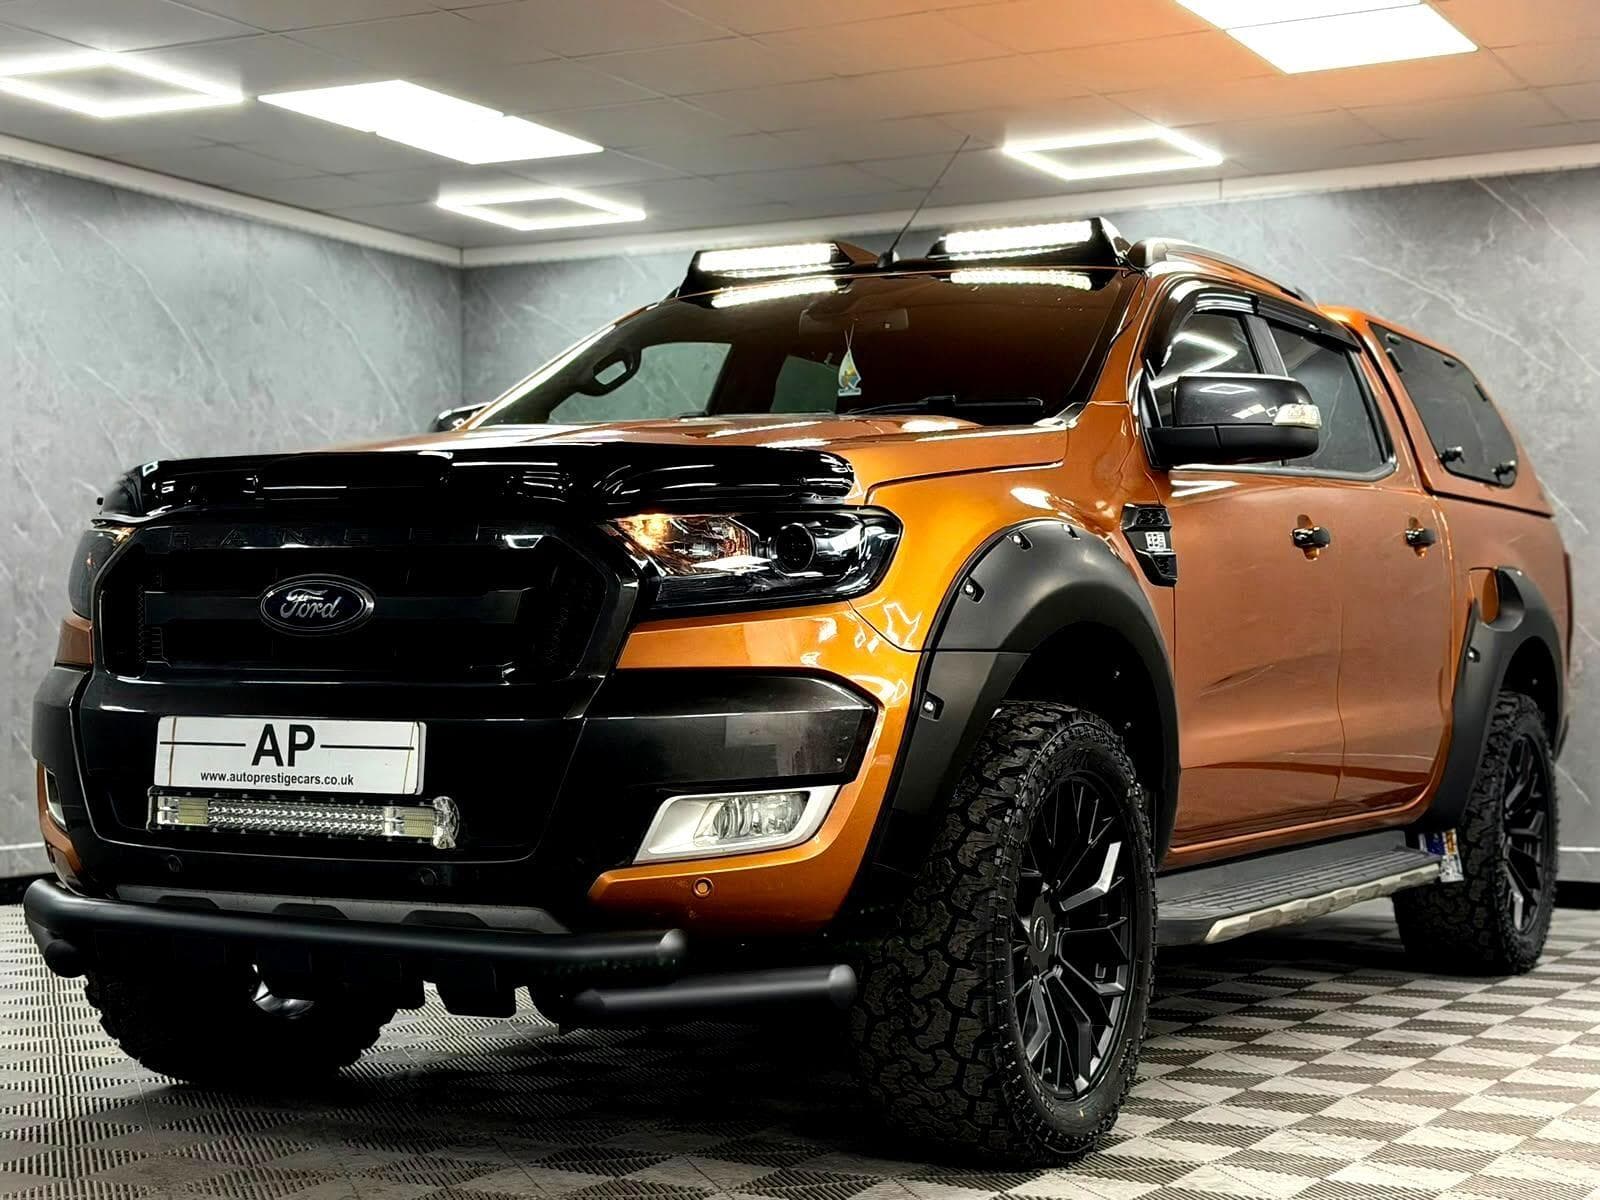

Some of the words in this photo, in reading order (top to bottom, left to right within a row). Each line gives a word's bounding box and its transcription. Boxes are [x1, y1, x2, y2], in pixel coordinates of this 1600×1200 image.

[280, 588, 342, 618] Ford
[251, 723, 315, 767] AP
[200, 771, 354, 786] www.autoprestigecars.co.uk
